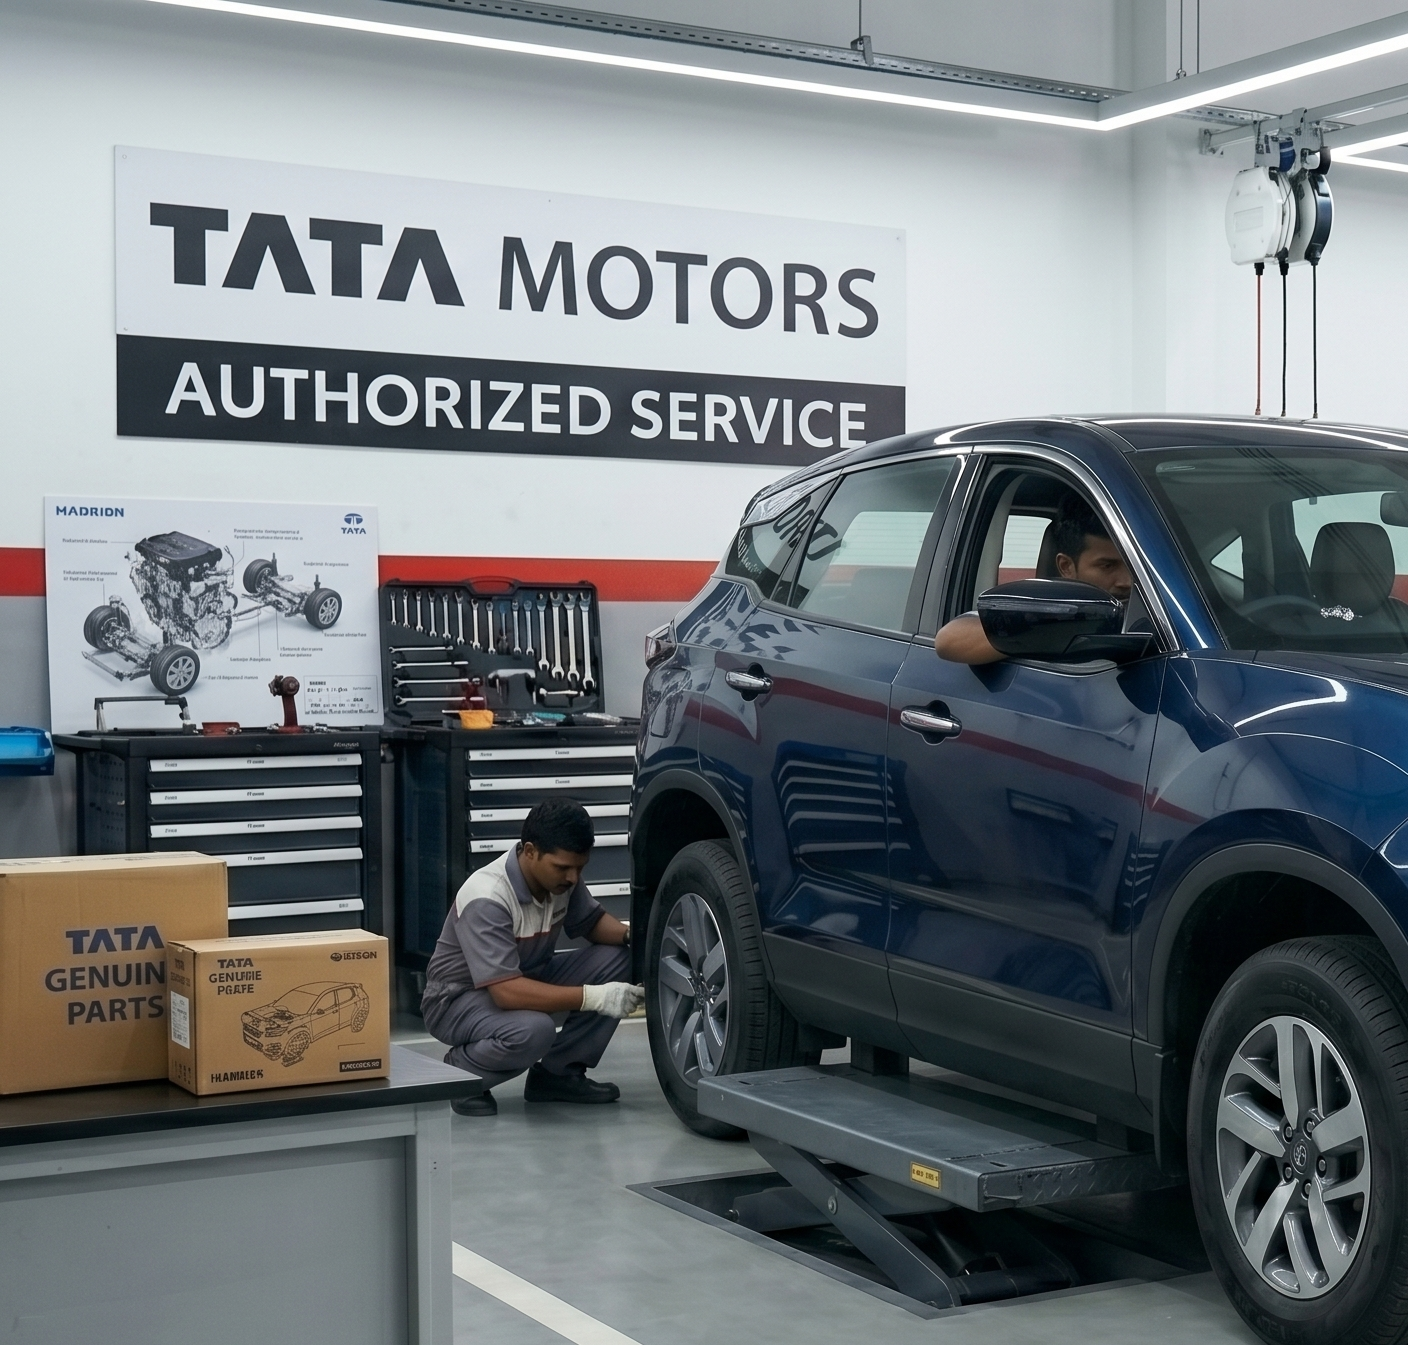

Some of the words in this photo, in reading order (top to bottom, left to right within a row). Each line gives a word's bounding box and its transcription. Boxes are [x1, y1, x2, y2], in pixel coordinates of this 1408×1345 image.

[150, 202, 465, 307] TATA
[498, 236, 879, 339] MOTORS
[165, 362, 612, 436] AUTHORIZED
[631, 390, 867, 450] SERVICE
[341, 527, 366, 535] TATA
[65, 925, 165, 955] TATA
[45, 961, 165, 992] GENUIN
[217, 957, 254, 969] TATA
[68, 995, 164, 1025] PARTS
